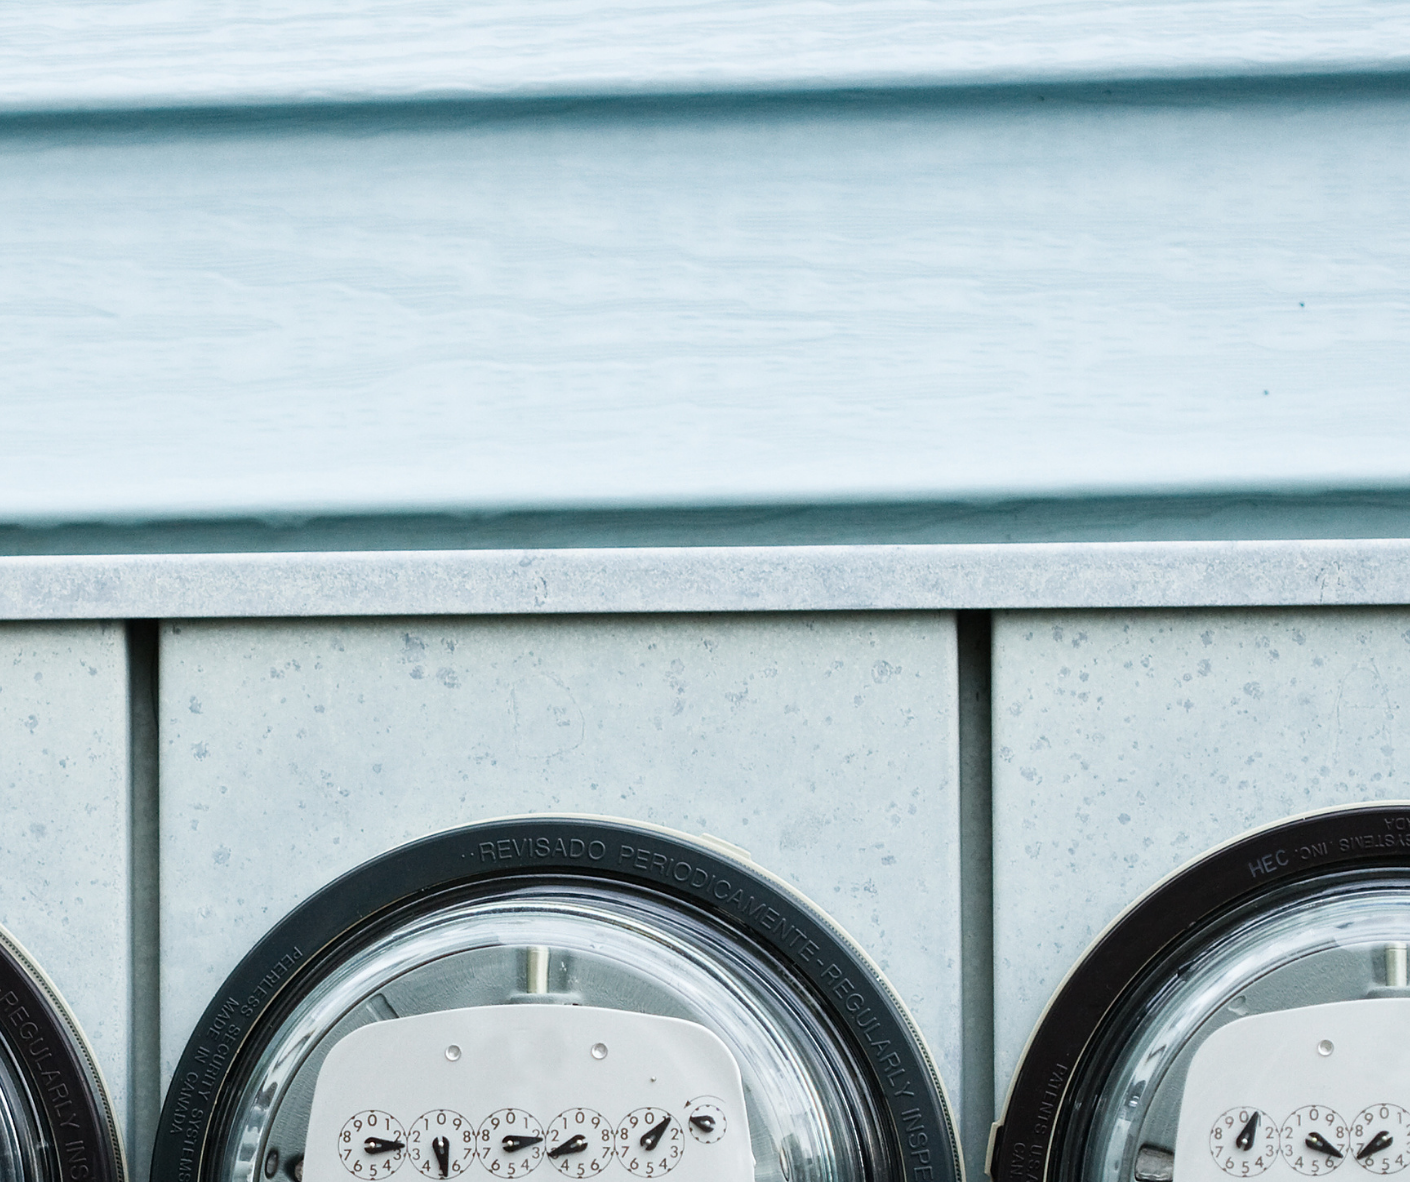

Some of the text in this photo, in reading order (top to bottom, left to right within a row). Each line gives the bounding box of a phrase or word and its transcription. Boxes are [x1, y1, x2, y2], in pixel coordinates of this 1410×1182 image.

[479, 837, 607, 864] REVISADO
[1247, 849, 1290, 879] HEC
[241, 944, 304, 1018] PEERLESS
[169, 996, 240, 1136] MADE IN CANADA
[198, 1023, 241, 1102] SECURITY
[1034, 1062, 1069, 1136] PATENTS
